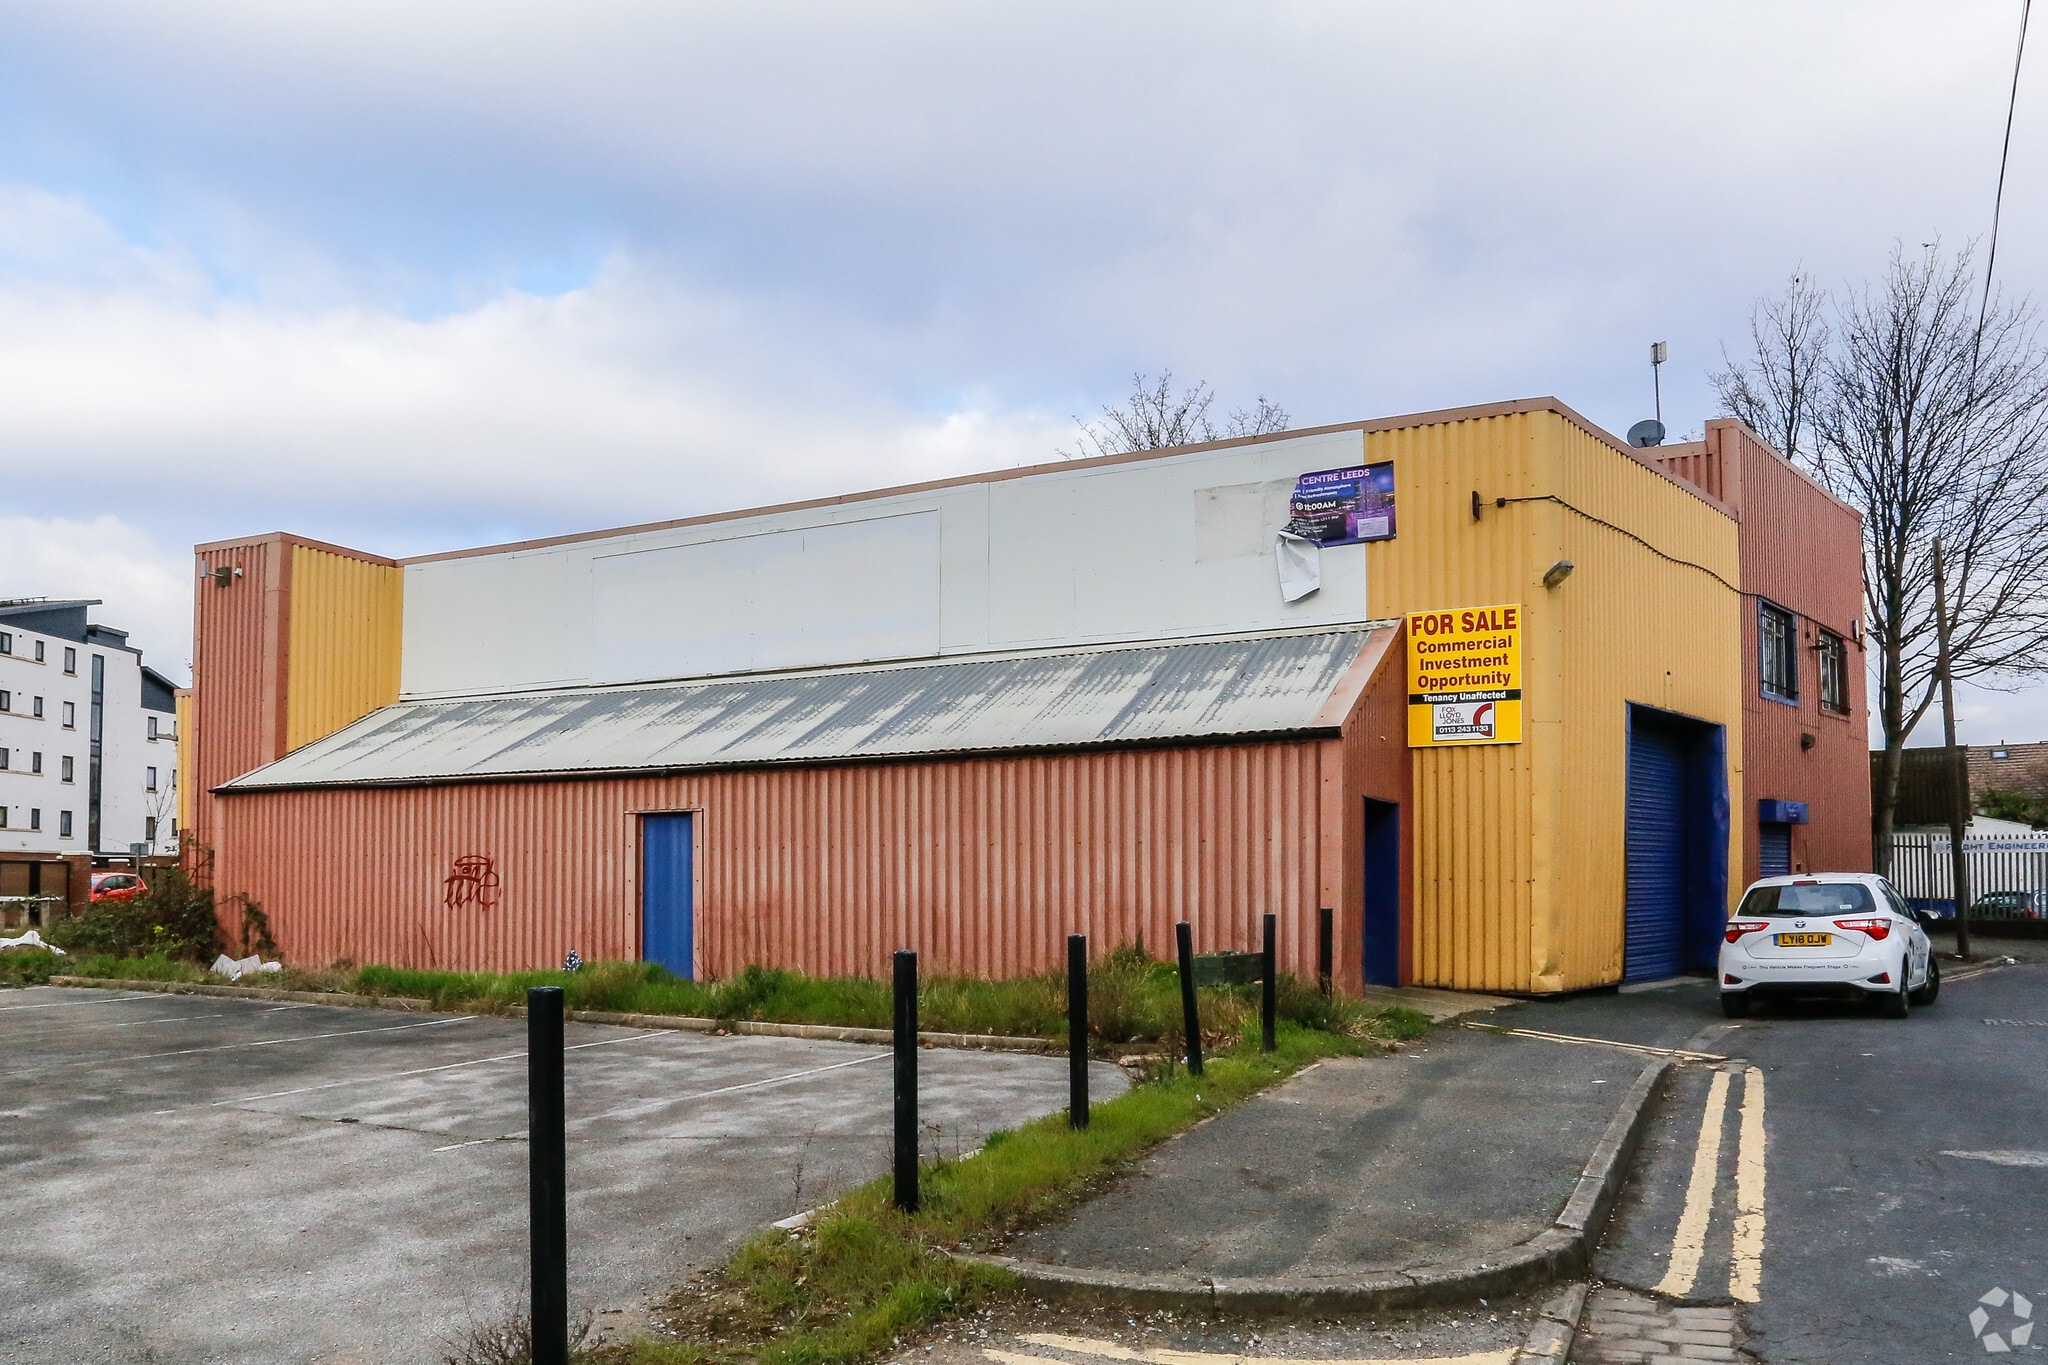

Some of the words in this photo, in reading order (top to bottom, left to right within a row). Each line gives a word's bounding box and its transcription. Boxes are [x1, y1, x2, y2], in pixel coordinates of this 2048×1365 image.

[1301, 473, 1339, 485] CENTRE
[1341, 468, 1370, 480] LEEDS
[1411, 614, 1454, 636] FOR
[1461, 609, 1517, 633] SALE
[1416, 635, 1512, 654] Commercial
[1420, 653, 1509, 671] Investment
[1417, 671, 1511, 690] Opportunity
[1422, 694, 1458, 703] Tenancy
[1459, 690, 1507, 701] Unaffected
[1442, 717, 1465, 725] JONES
[1782, 935, 1805, 945] LY18
